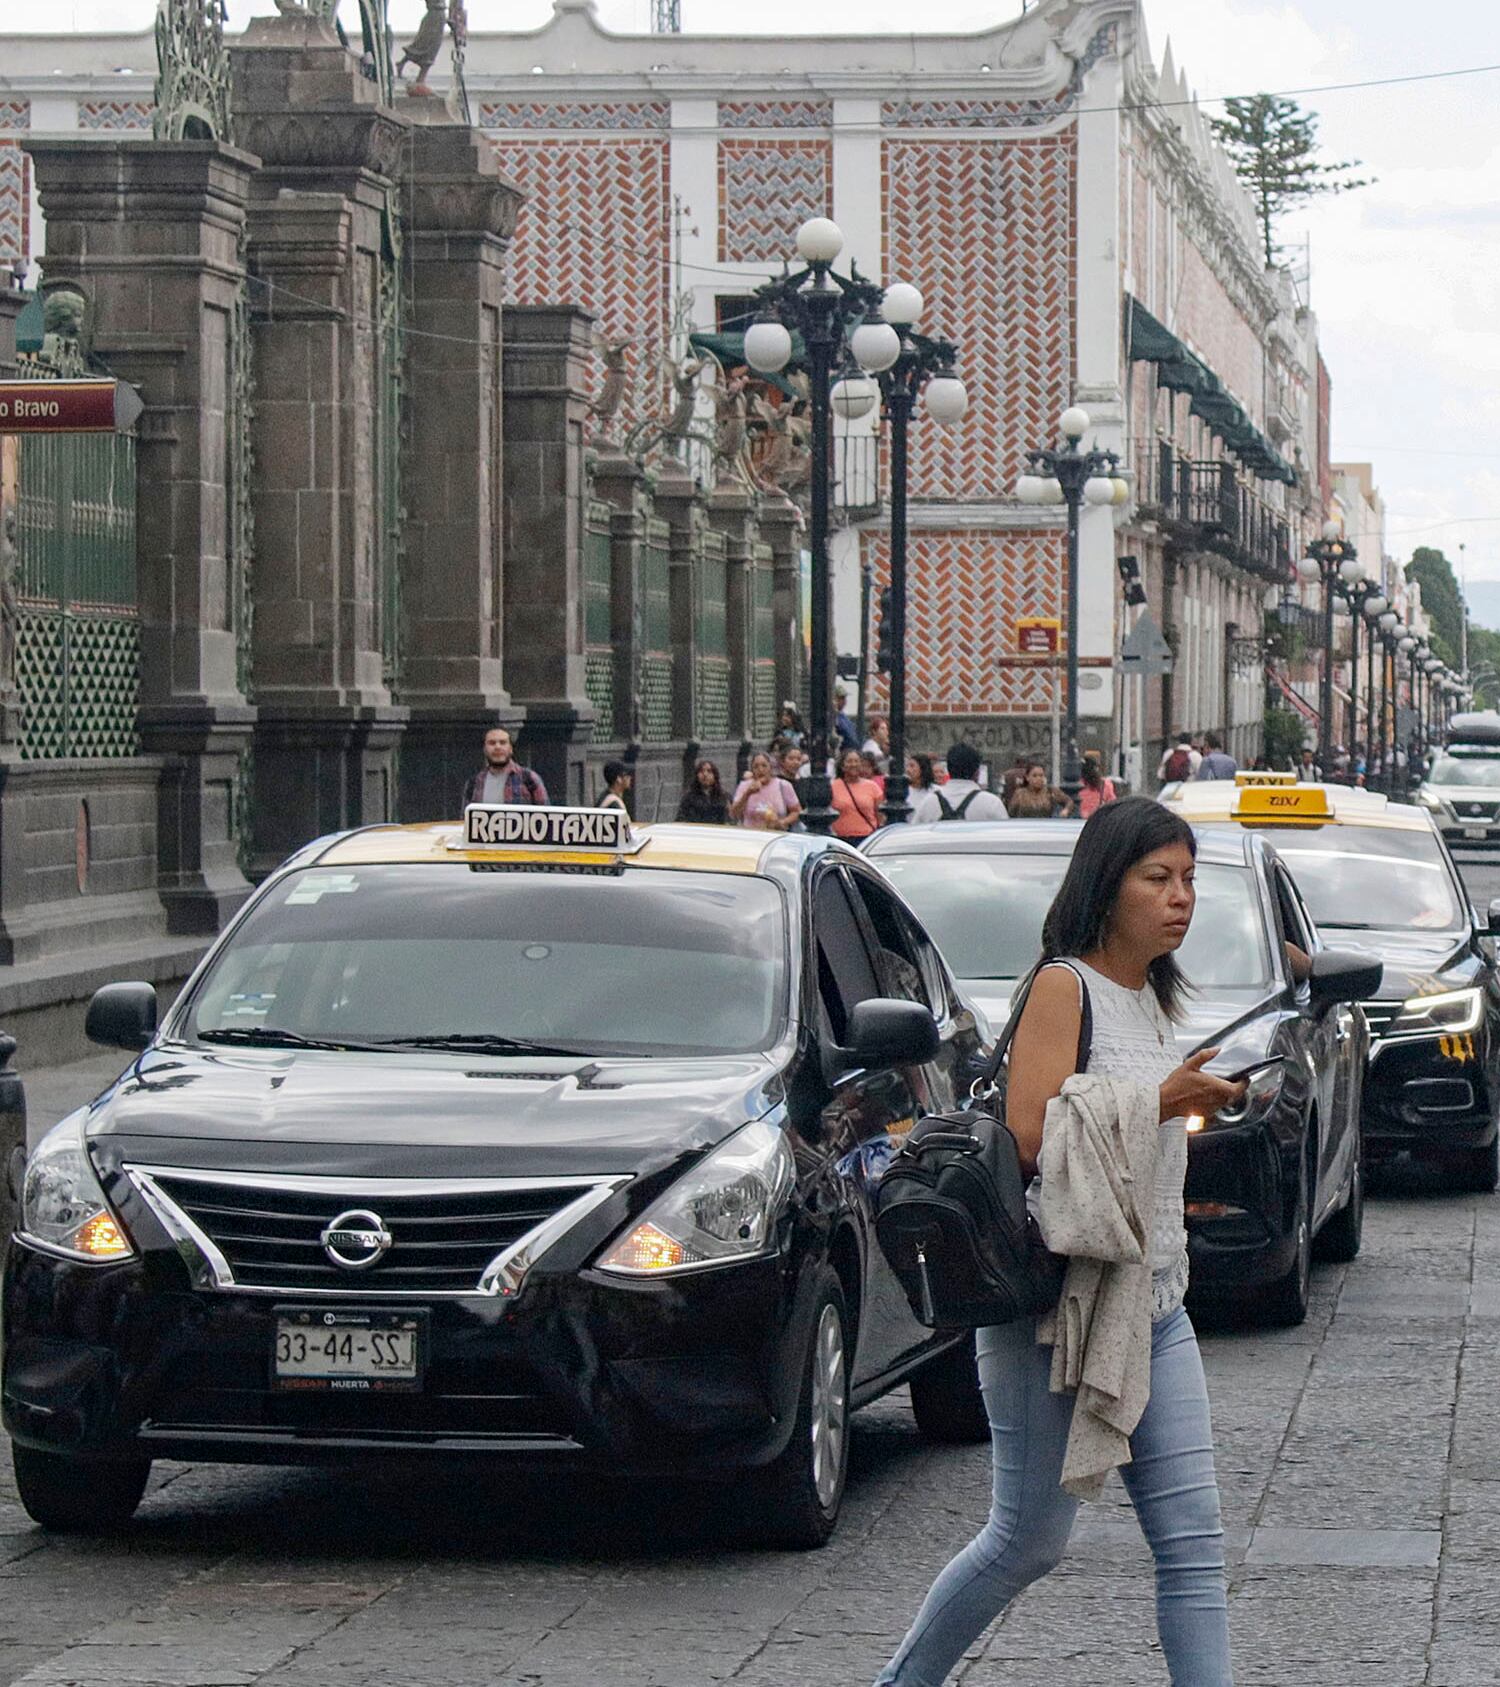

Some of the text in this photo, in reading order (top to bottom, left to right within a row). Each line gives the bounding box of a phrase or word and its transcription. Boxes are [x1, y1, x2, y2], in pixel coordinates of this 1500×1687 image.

[14, 399, 59, 416] Bravo
[471, 811, 616, 844] RADIOTAXIS
[328, 1233, 384, 1244] NISSAN
[330, 1380, 370, 1390] HUERTA
